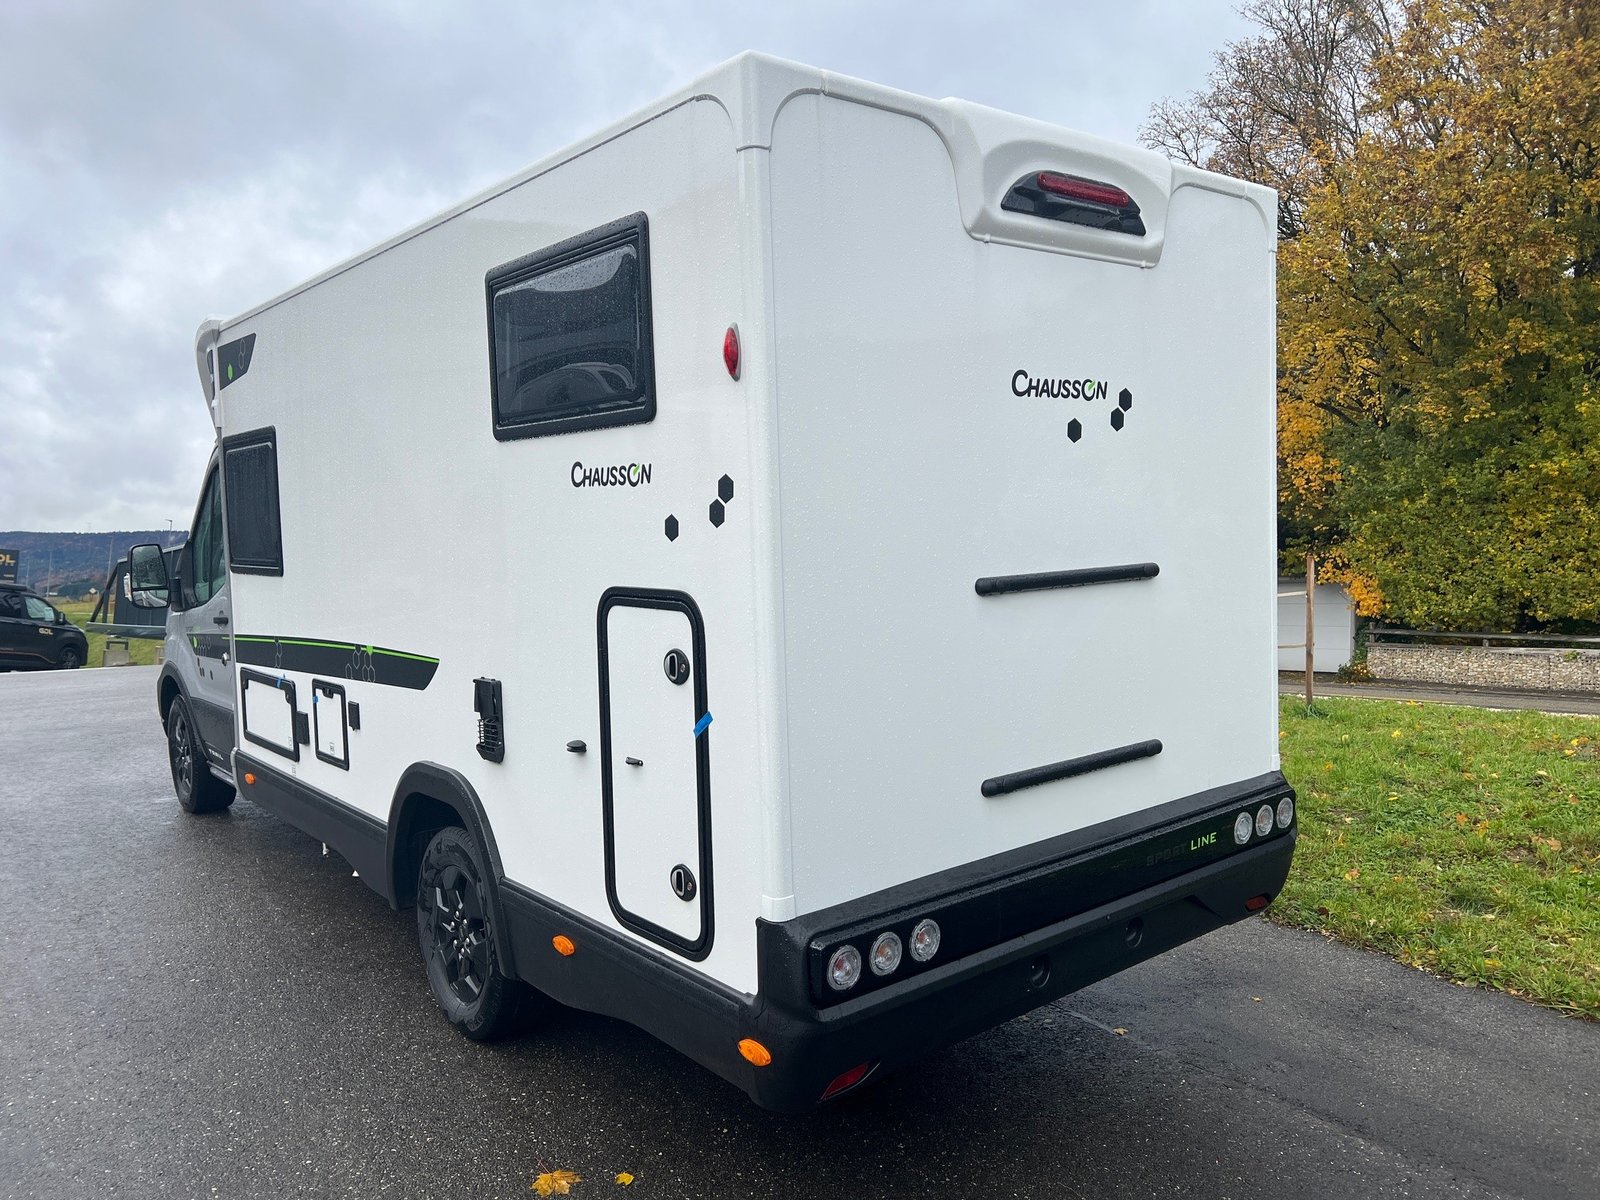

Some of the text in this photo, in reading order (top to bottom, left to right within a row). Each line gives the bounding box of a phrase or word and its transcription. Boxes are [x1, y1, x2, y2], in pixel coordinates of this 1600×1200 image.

[1011, 369, 1107, 401] CHAUSSON
[571, 461, 652, 487] CHAUSSON
[1190, 832, 1217, 851] LINE
